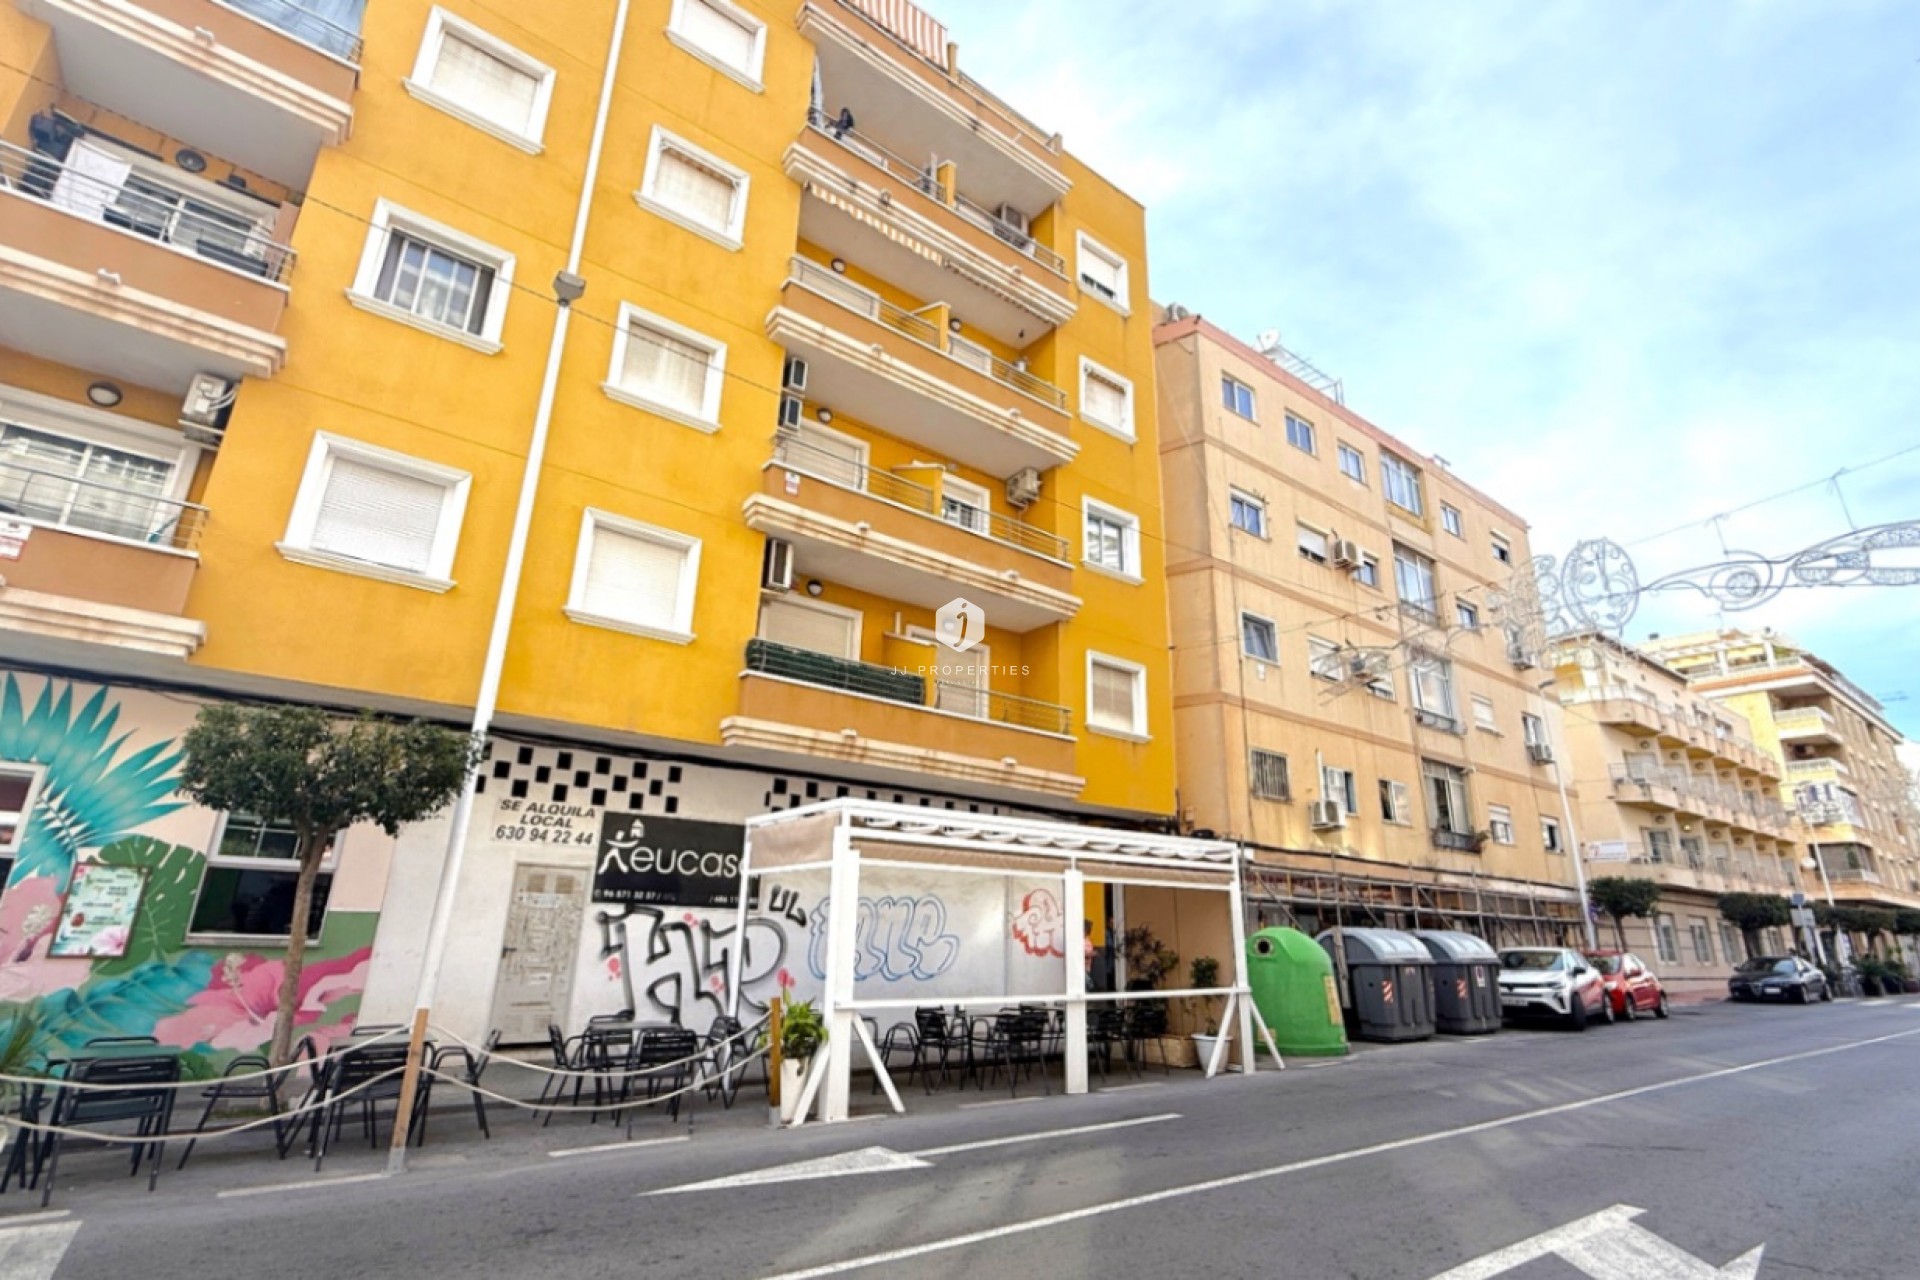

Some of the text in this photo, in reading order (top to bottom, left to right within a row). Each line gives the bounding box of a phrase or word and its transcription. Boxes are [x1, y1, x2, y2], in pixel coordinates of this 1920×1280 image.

[501, 799, 595, 819] SE ALQUILA
[520, 814, 573, 829] LOCAL
[496, 825, 593, 845] 630 94 22 44
